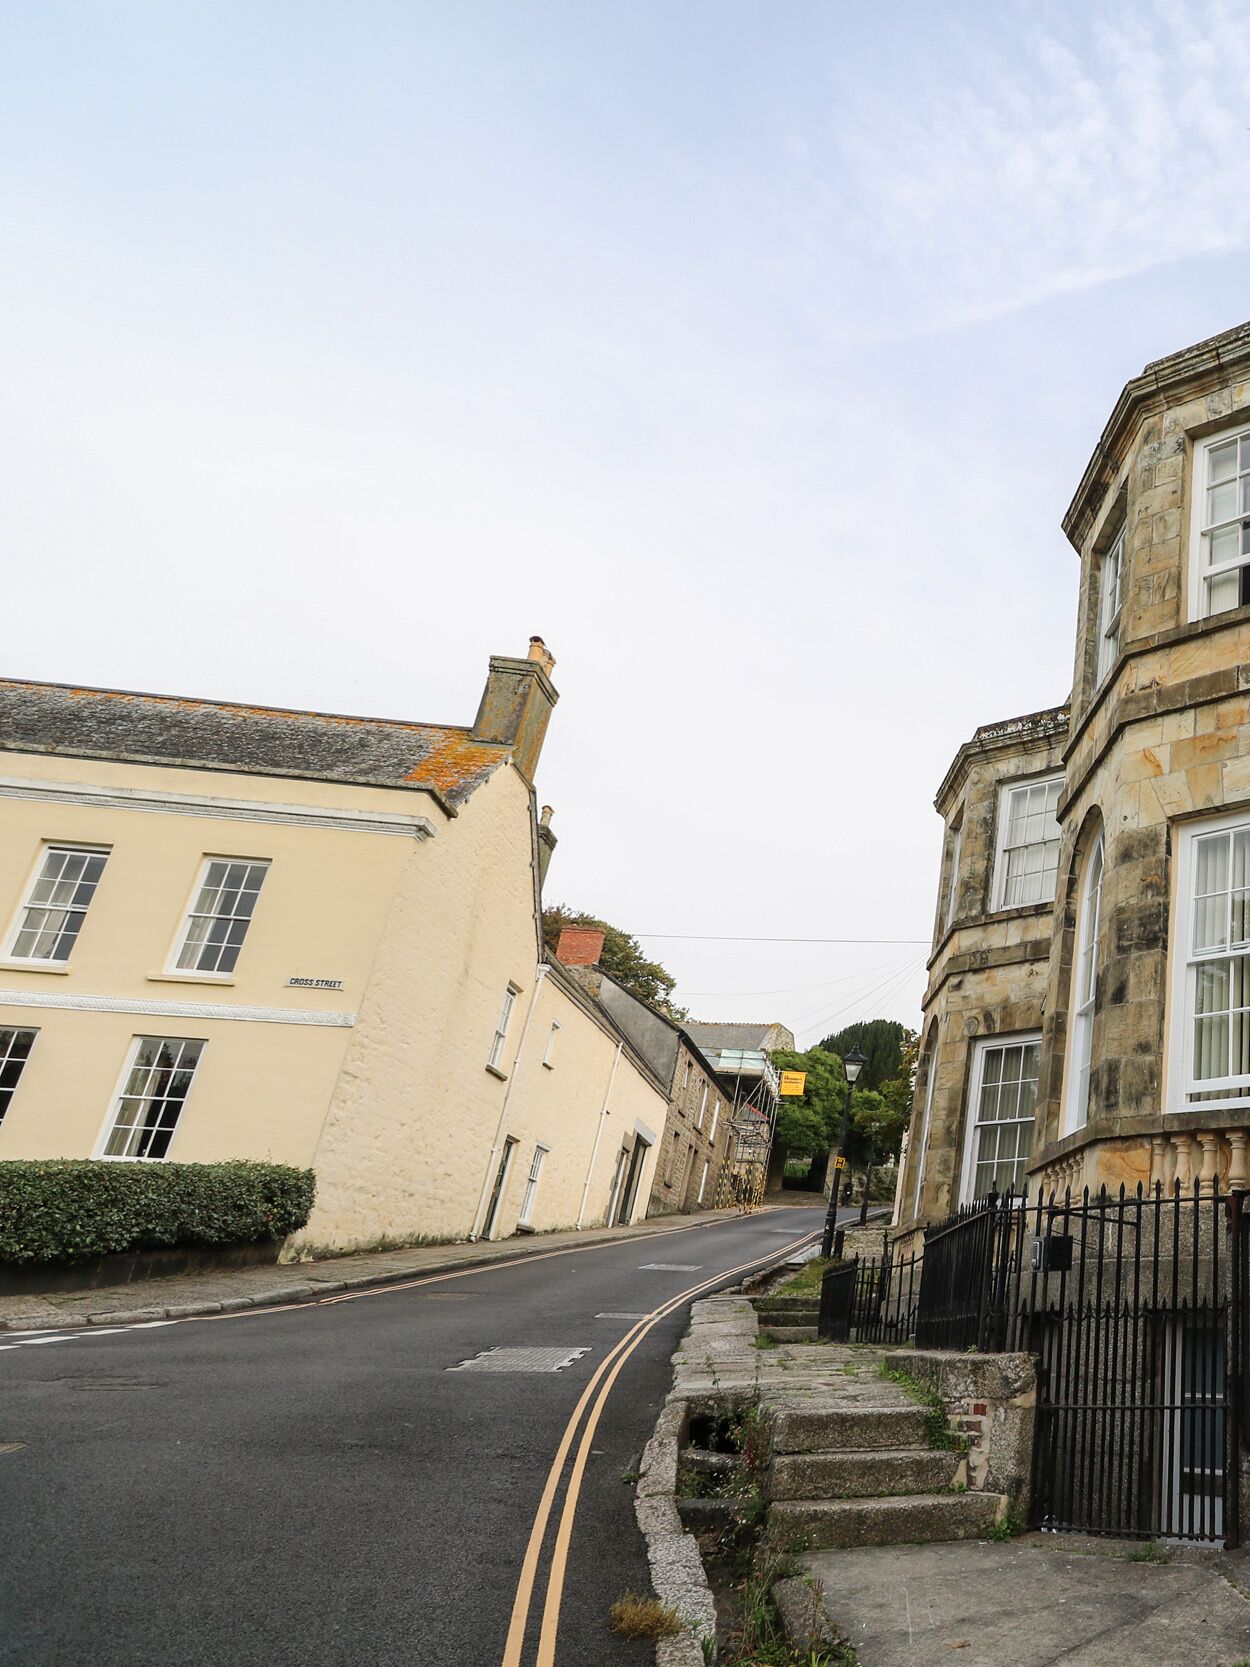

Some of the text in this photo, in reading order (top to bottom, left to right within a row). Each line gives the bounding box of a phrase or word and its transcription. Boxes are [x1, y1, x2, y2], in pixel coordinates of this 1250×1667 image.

[289, 977, 343, 988] CROSS STREET
[835, 1158, 845, 1168] H
